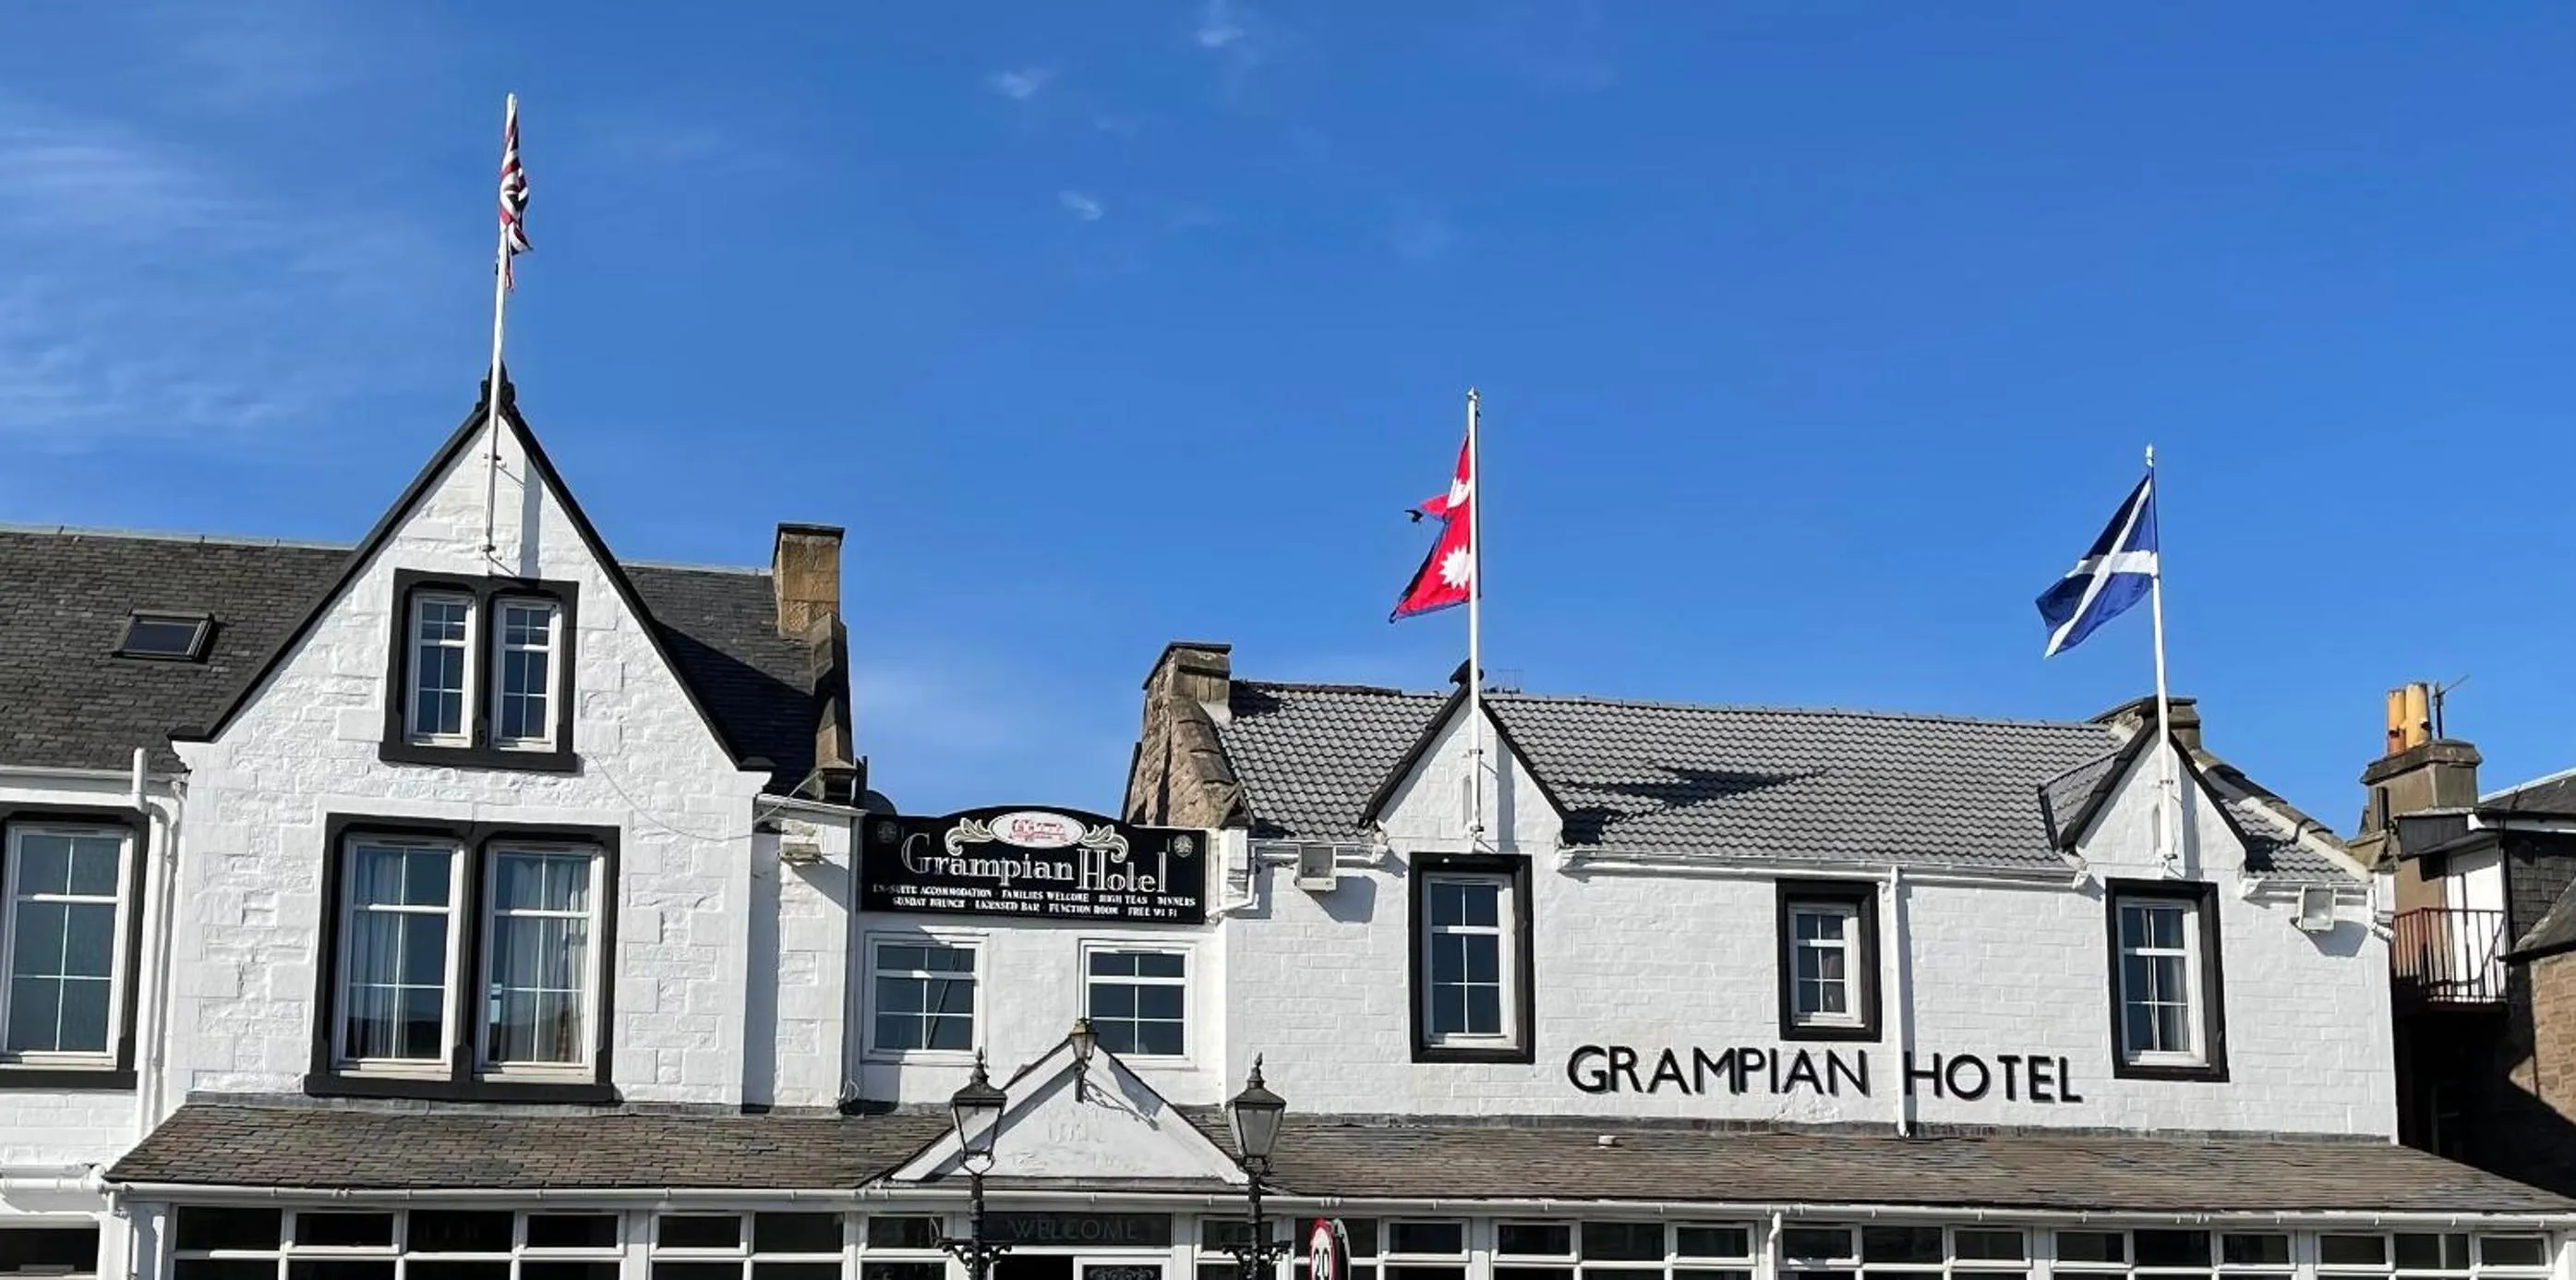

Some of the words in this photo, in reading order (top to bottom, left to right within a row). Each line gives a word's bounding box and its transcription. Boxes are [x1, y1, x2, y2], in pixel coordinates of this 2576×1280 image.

[901, 833, 1074, 888] Grampian
[1076, 848, 1167, 893] Hotel
[893, 897, 926, 907] SUNDAY
[930, 899, 966, 909] BRUNCH
[975, 900, 1019, 912] LICENSED
[1020, 902, 1041, 912] BAR
[1049, 902, 1091, 914] FUNCTION
[1093, 904, 1119, 914] ROOM
[1127, 906, 1150, 916] FREE
[921, 886, 993, 898] ACCOMMODATION
[1002, 889, 1043, 900] FAMILIES
[1046, 891, 1089, 902] WELCOME
[1099, 894, 1122, 904] HIGH
[1125, 895, 1148, 905] TEAS
[1157, 896, 1196, 907] DINNERS
[1567, 1045, 1870, 1097] GRAMPIAN
[1904, 1050, 2083, 1103] HOTEL
[1009, 1218, 1138, 1240] WELCOME
[1313, 1248, 1330, 1280] 20
